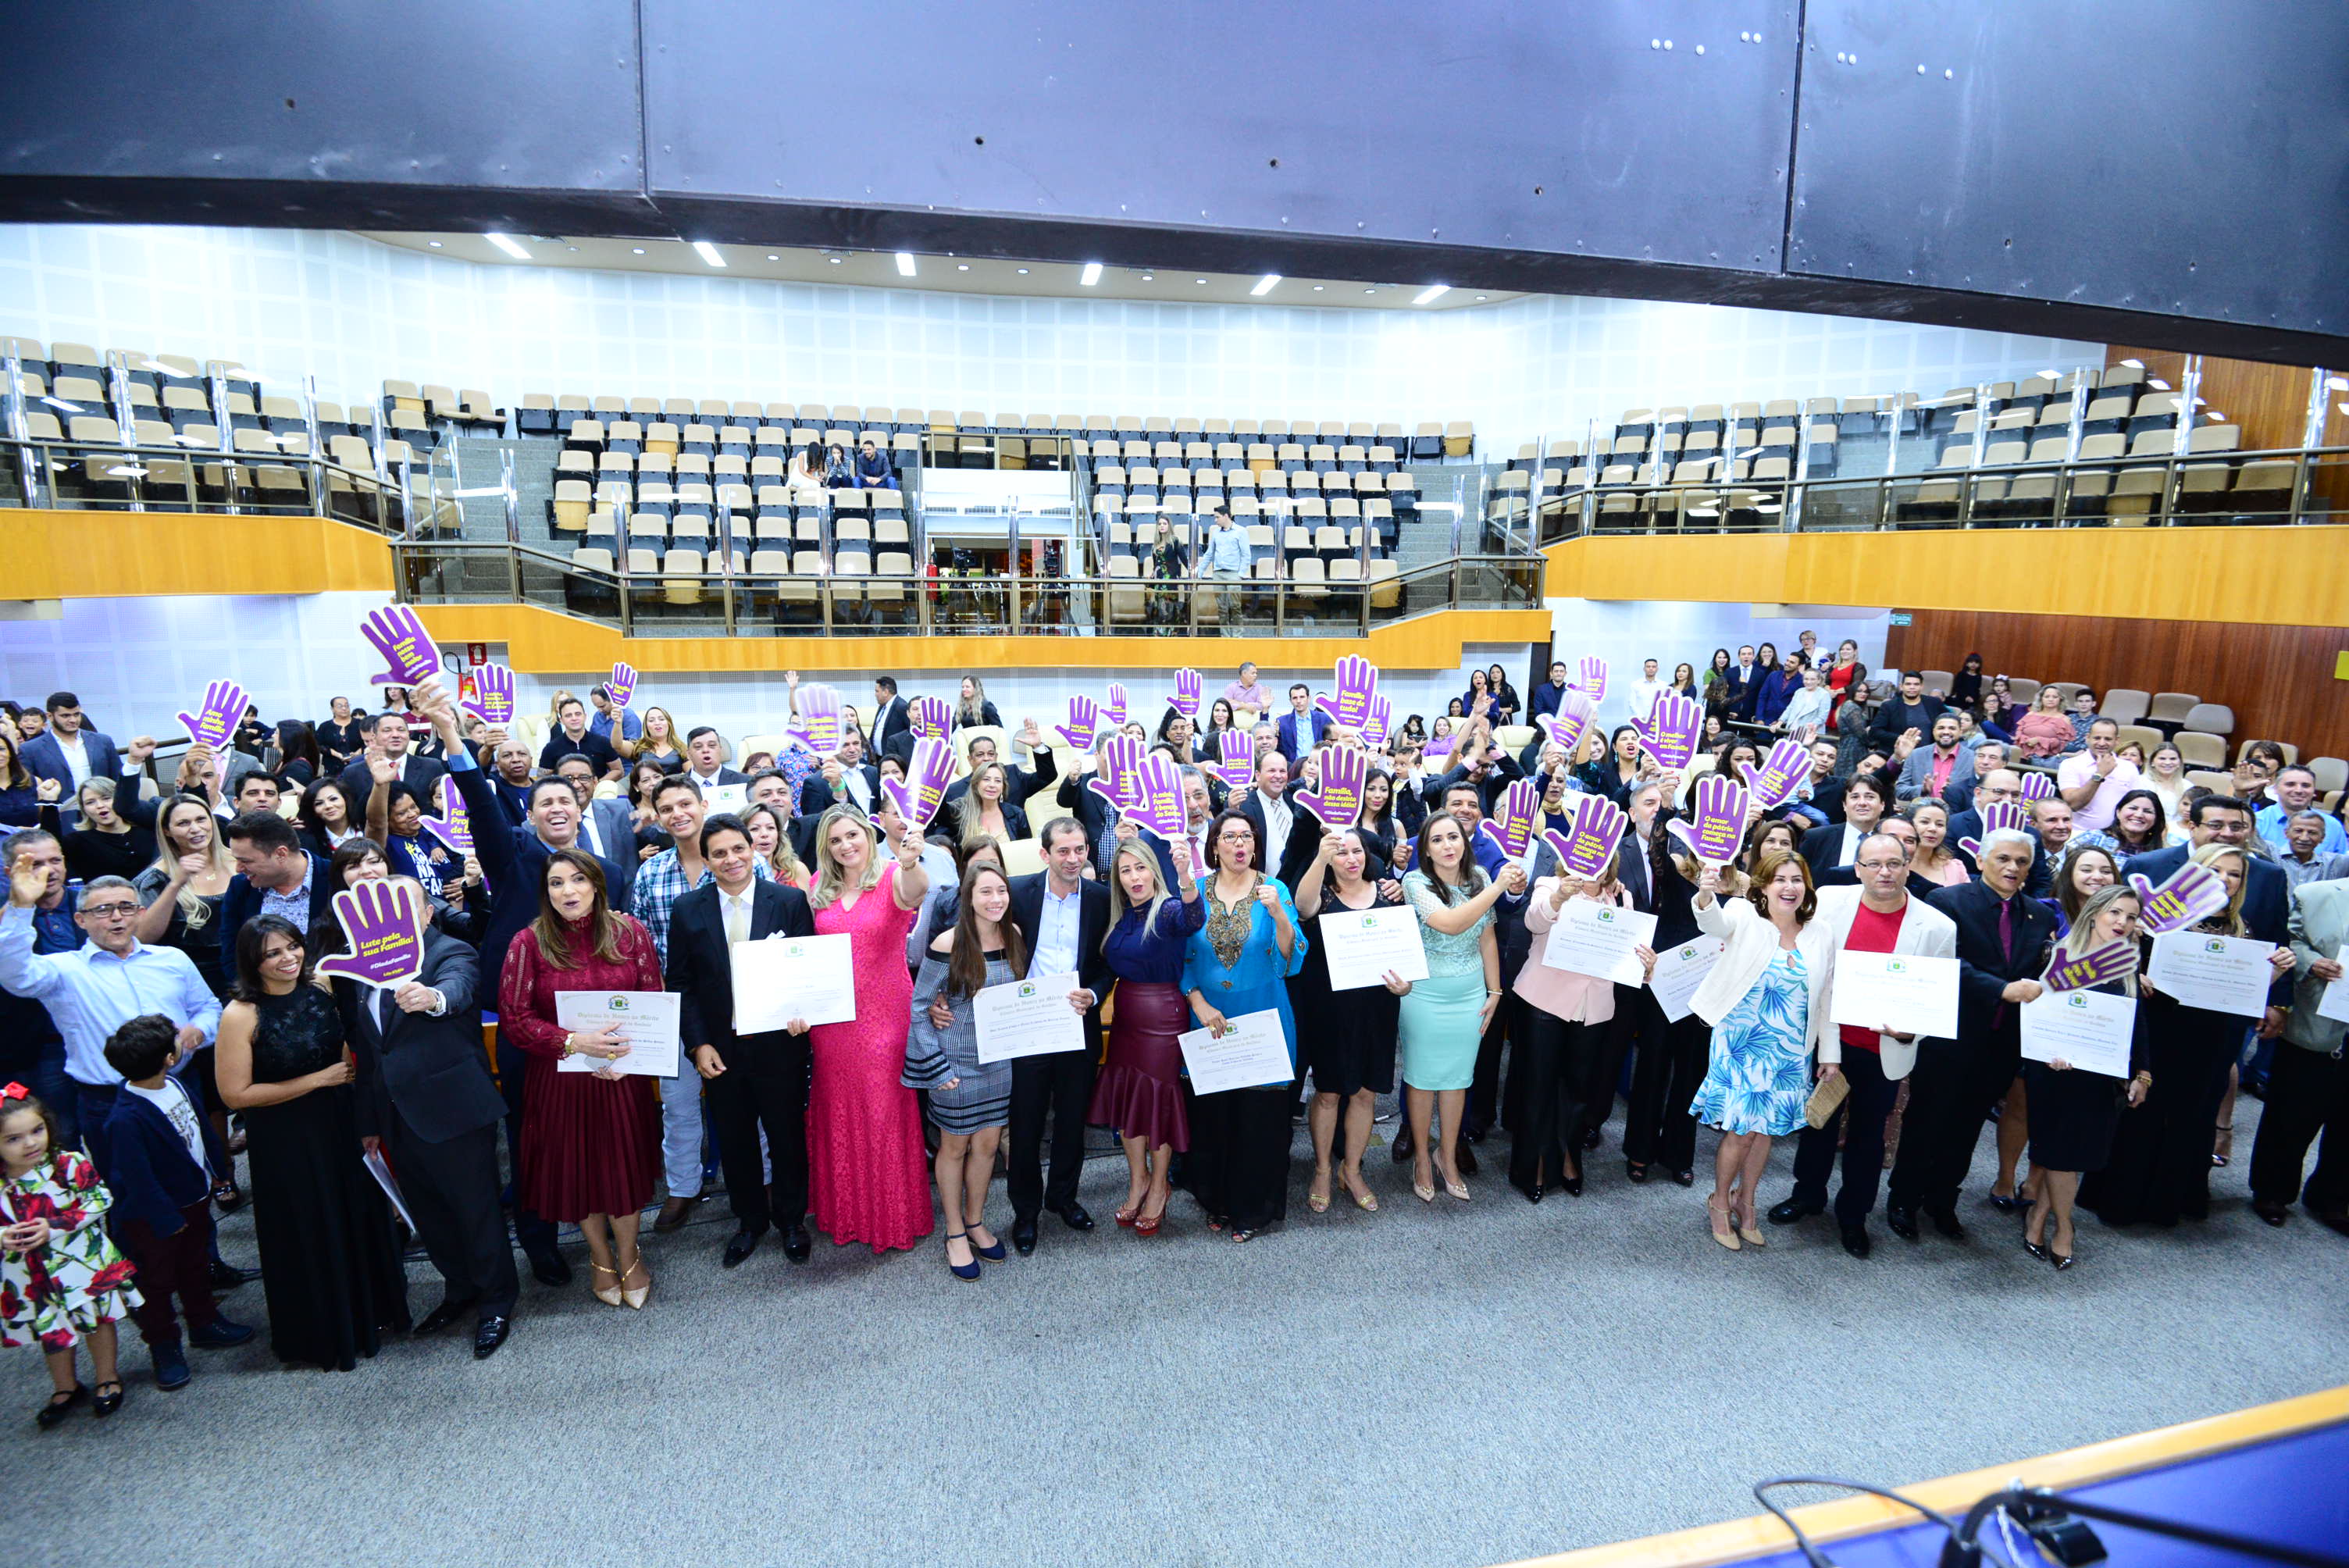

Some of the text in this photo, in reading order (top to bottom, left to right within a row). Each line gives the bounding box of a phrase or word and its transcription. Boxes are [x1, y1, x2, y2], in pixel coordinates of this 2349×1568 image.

[393, 636, 416, 651] Família
[400, 652, 415, 662] bem
[405, 654, 422, 668] maior
[1342, 690, 1365, 700] Família
[205, 709, 223, 718] Amo
[203, 717, 225, 726] minha
[200, 722, 226, 733] Família
[1324, 786, 1353, 796] Família,
[451, 825, 462, 834] de
[1712, 823, 1734, 832] pátria
[1585, 834, 1602, 843] amor
[1701, 835, 1725, 843] Família
[1702, 829, 1725, 839] começa
[1574, 844, 1596, 855] começa
[1585, 840, 1605, 851] pátria
[1572, 848, 1594, 860] Família
[361, 932, 401, 950] Lute pela
[363, 935, 414, 957] sua Família!
